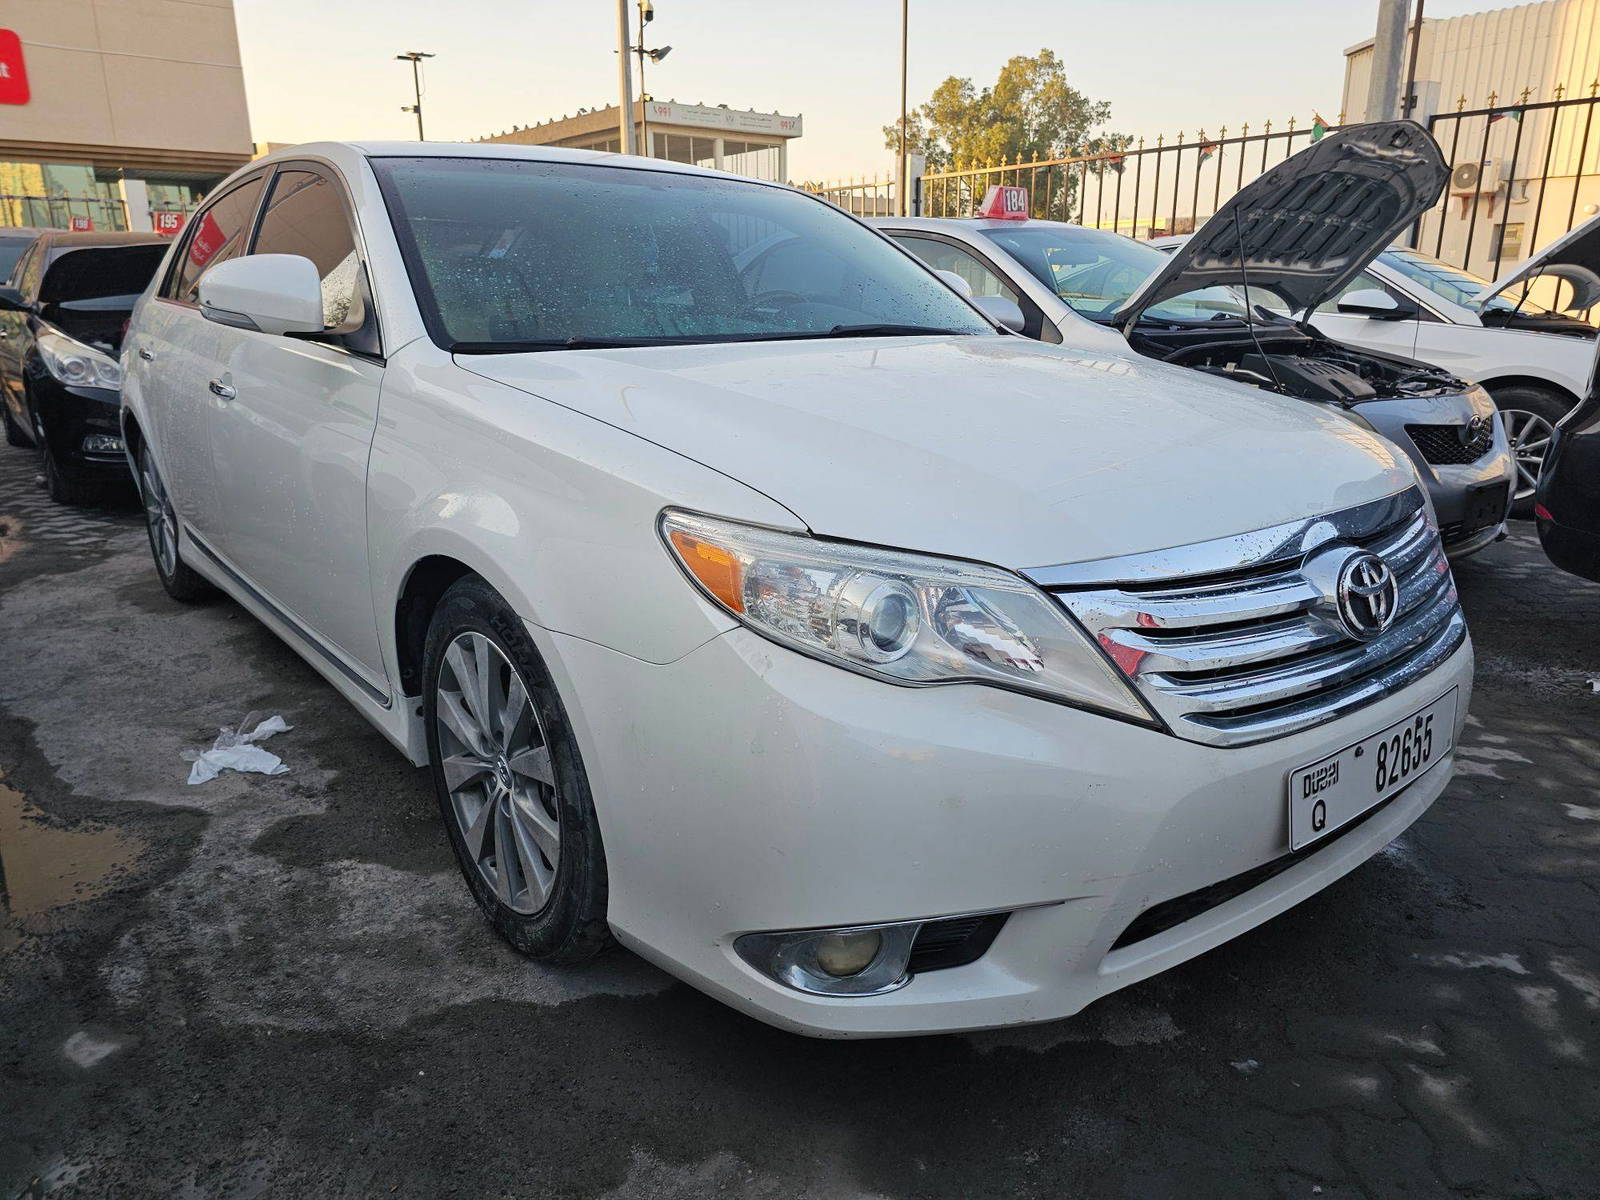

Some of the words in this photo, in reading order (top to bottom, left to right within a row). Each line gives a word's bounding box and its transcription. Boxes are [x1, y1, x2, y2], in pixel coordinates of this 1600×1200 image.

[1006, 190, 1025, 211] 184
[160, 214, 178, 228] 195
[1375, 712, 1434, 792] 82655
[1312, 799, 1326, 832] Q
